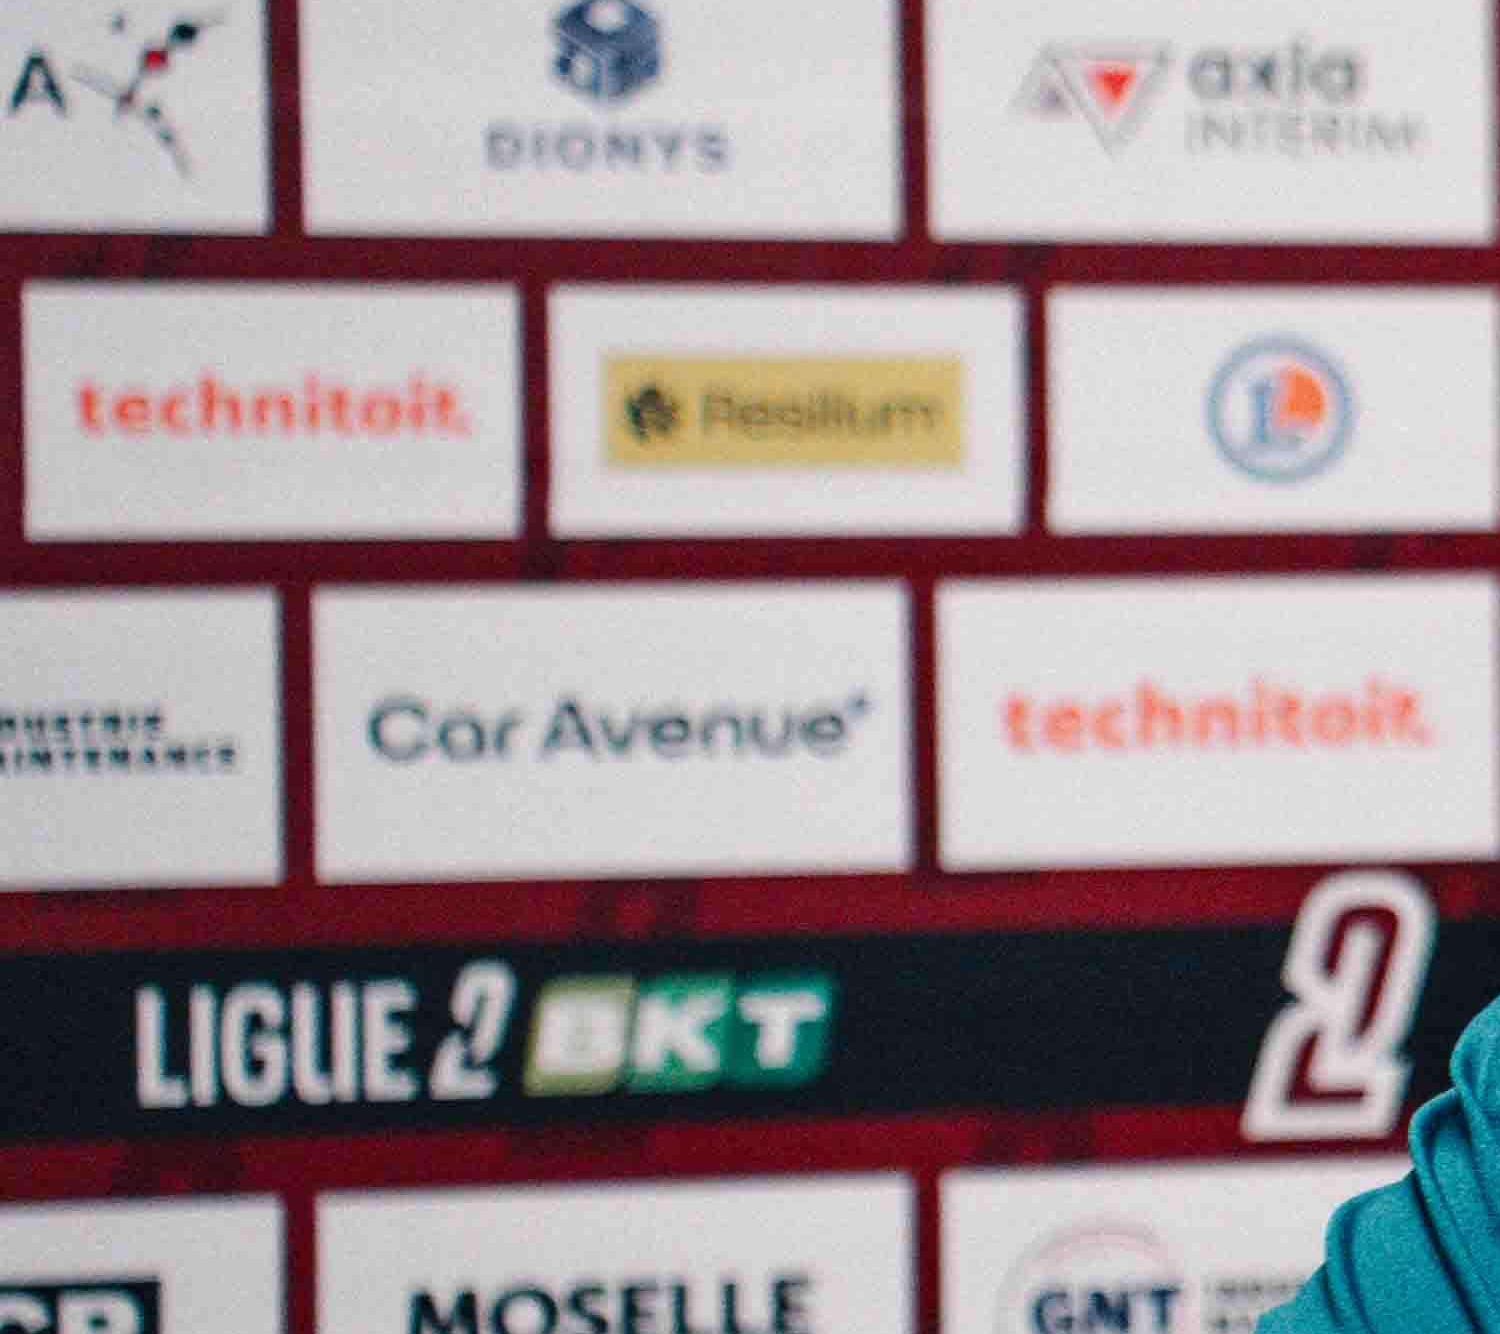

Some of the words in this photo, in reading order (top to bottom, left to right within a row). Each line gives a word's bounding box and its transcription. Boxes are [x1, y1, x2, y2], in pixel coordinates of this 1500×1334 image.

[1188, 42, 1363, 104] axia
[484, 123, 727, 171] DIONYS
[1187, 107, 1420, 157] INTERIM
[78, 367, 474, 443] technitoit.
[366, 696, 520, 763] Car
[1003, 680, 1436, 752] technitoit.
[138, 984, 413, 1106] LIGUE
[431, 965, 511, 1098] 2
[531, 985, 828, 1077] BKT
